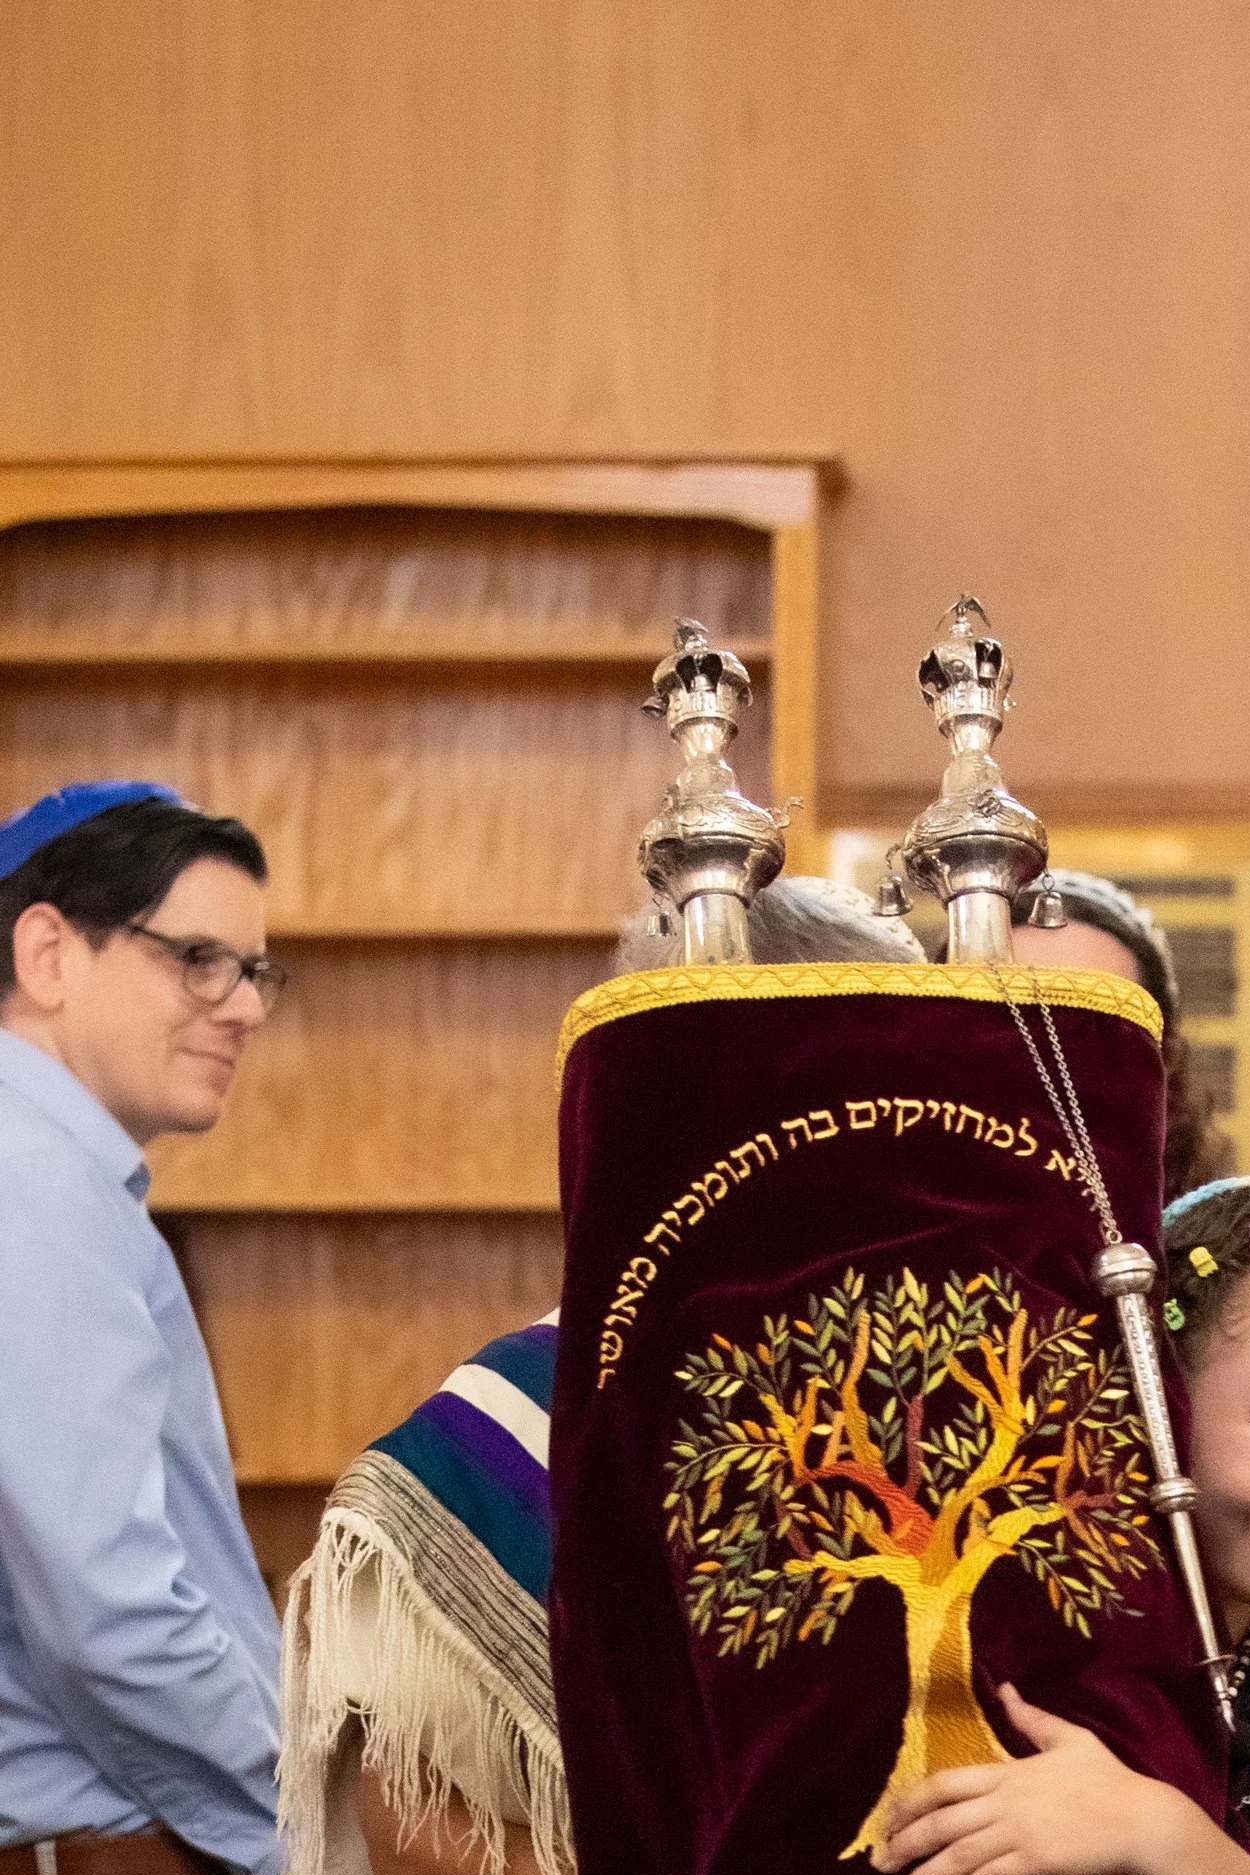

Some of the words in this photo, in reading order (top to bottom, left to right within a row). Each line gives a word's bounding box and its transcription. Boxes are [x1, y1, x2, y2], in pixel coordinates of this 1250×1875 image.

[780, 1109, 840, 1150] בה
[845, 1096, 1038, 1157] למחזיקים
[643, 1133, 779, 1256] ותומכיה
[597, 1256, 658, 1390] מאושר
